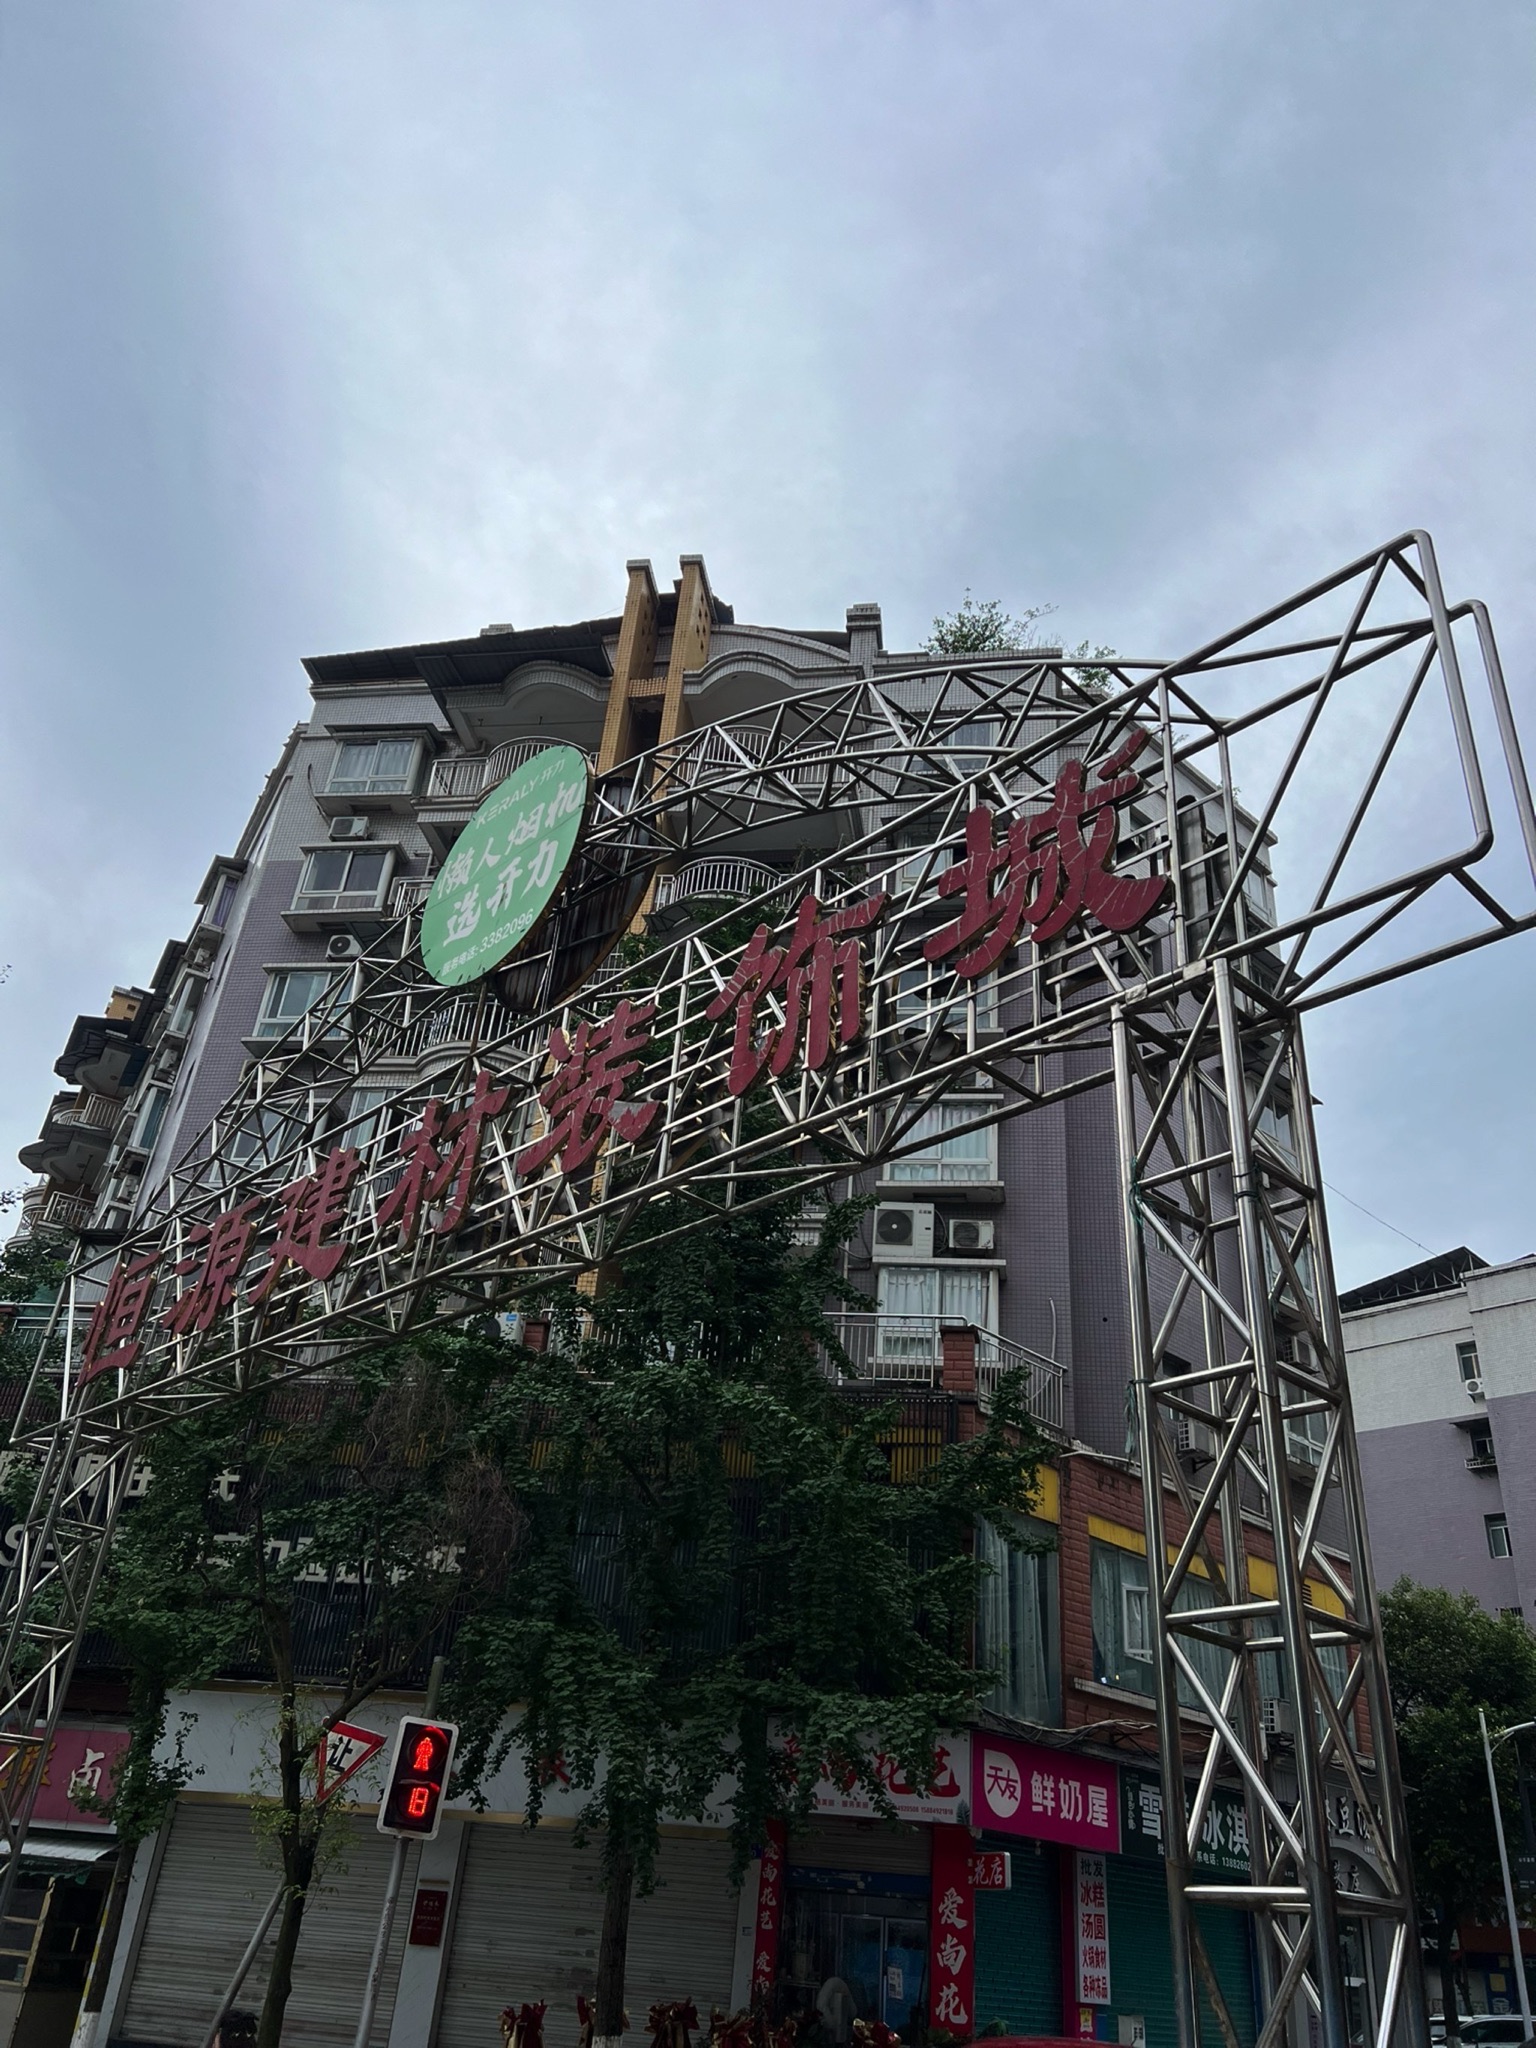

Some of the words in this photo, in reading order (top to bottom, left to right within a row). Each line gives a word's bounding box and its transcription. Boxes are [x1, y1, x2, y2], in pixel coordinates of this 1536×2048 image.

[437, 781, 584, 900] 懒人烟机
[328, 1735, 354, 1772] 让
[986, 1764, 1019, 1802] 天友
[1030, 1769, 1109, 1829] 鲜奶屋
[973, 1855, 1003, 1886] 花店
[1080, 1857, 1104, 1877] 批发
[760, 1839, 780, 1930] 爱尚花艺
[1080, 1880, 1105, 1909] 冰糕
[1081, 1912, 1106, 1941] 汤圆
[935, 1887, 968, 2025] 爱尚花
[1082, 1945, 1107, 1970] 火锅食材
[1083, 1974, 1108, 2000] 各种冻品
